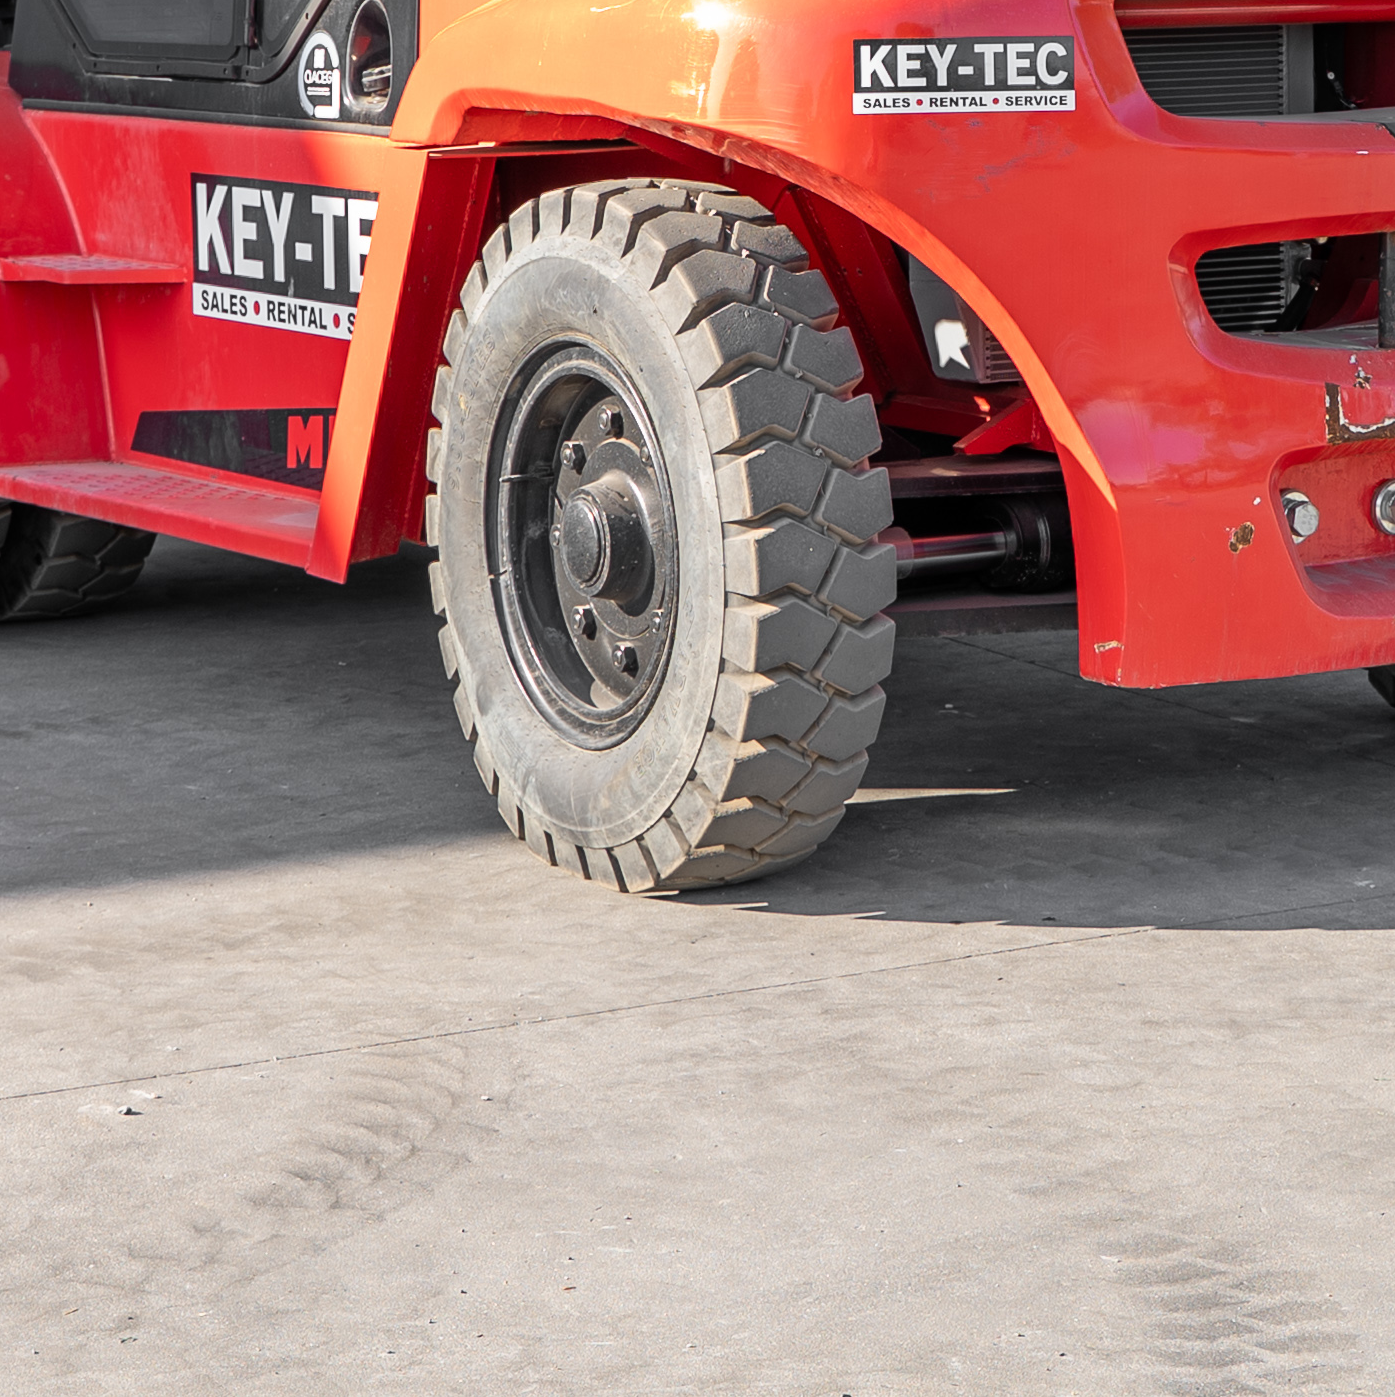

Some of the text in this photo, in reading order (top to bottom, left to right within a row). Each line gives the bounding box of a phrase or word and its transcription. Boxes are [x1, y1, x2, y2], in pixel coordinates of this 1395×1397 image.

[860, 42, 1069, 88] KEY-TEC
[863, 94, 1068, 109] SALES RENTAL SERVICE
[196, 182, 379, 293] KEY-TE
[201, 290, 248, 318] SALES
[267, 300, 328, 331] RENTAL
